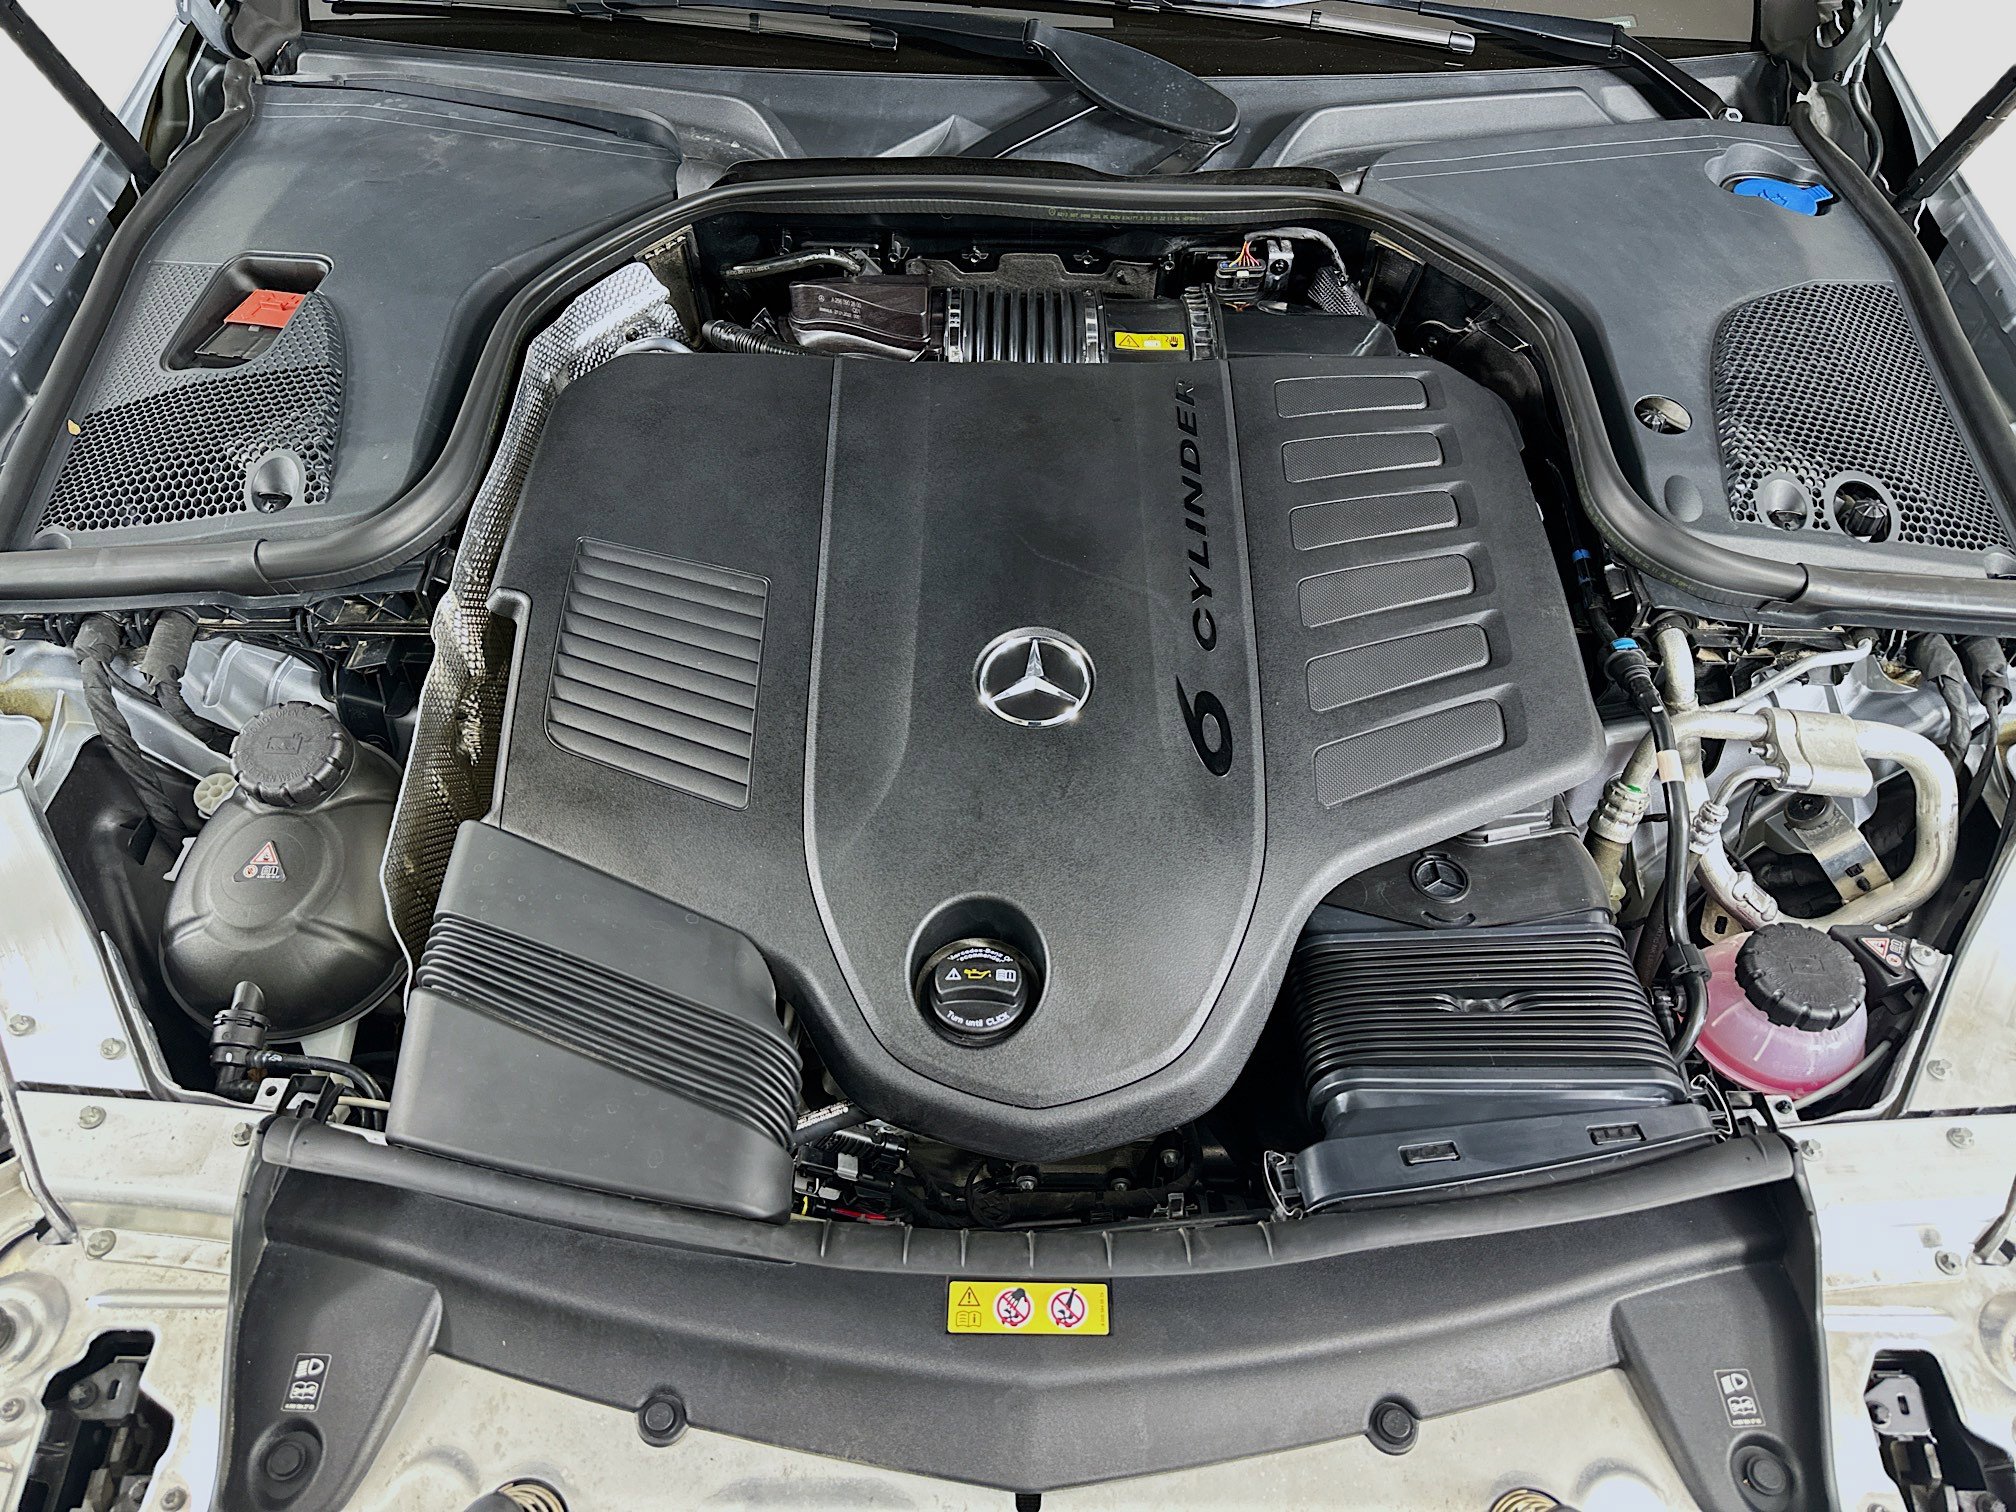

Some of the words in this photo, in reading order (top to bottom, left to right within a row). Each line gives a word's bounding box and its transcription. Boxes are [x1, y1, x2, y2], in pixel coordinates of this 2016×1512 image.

[1175, 376, 1217, 652] CYLINDER
[275, 708, 300, 719] OPEN
[1175, 674, 1234, 778] 6
[947, 1010, 964, 1024] Turn
[965, 1019, 984, 1027] until
[986, 1011, 1010, 1026] CLICK
